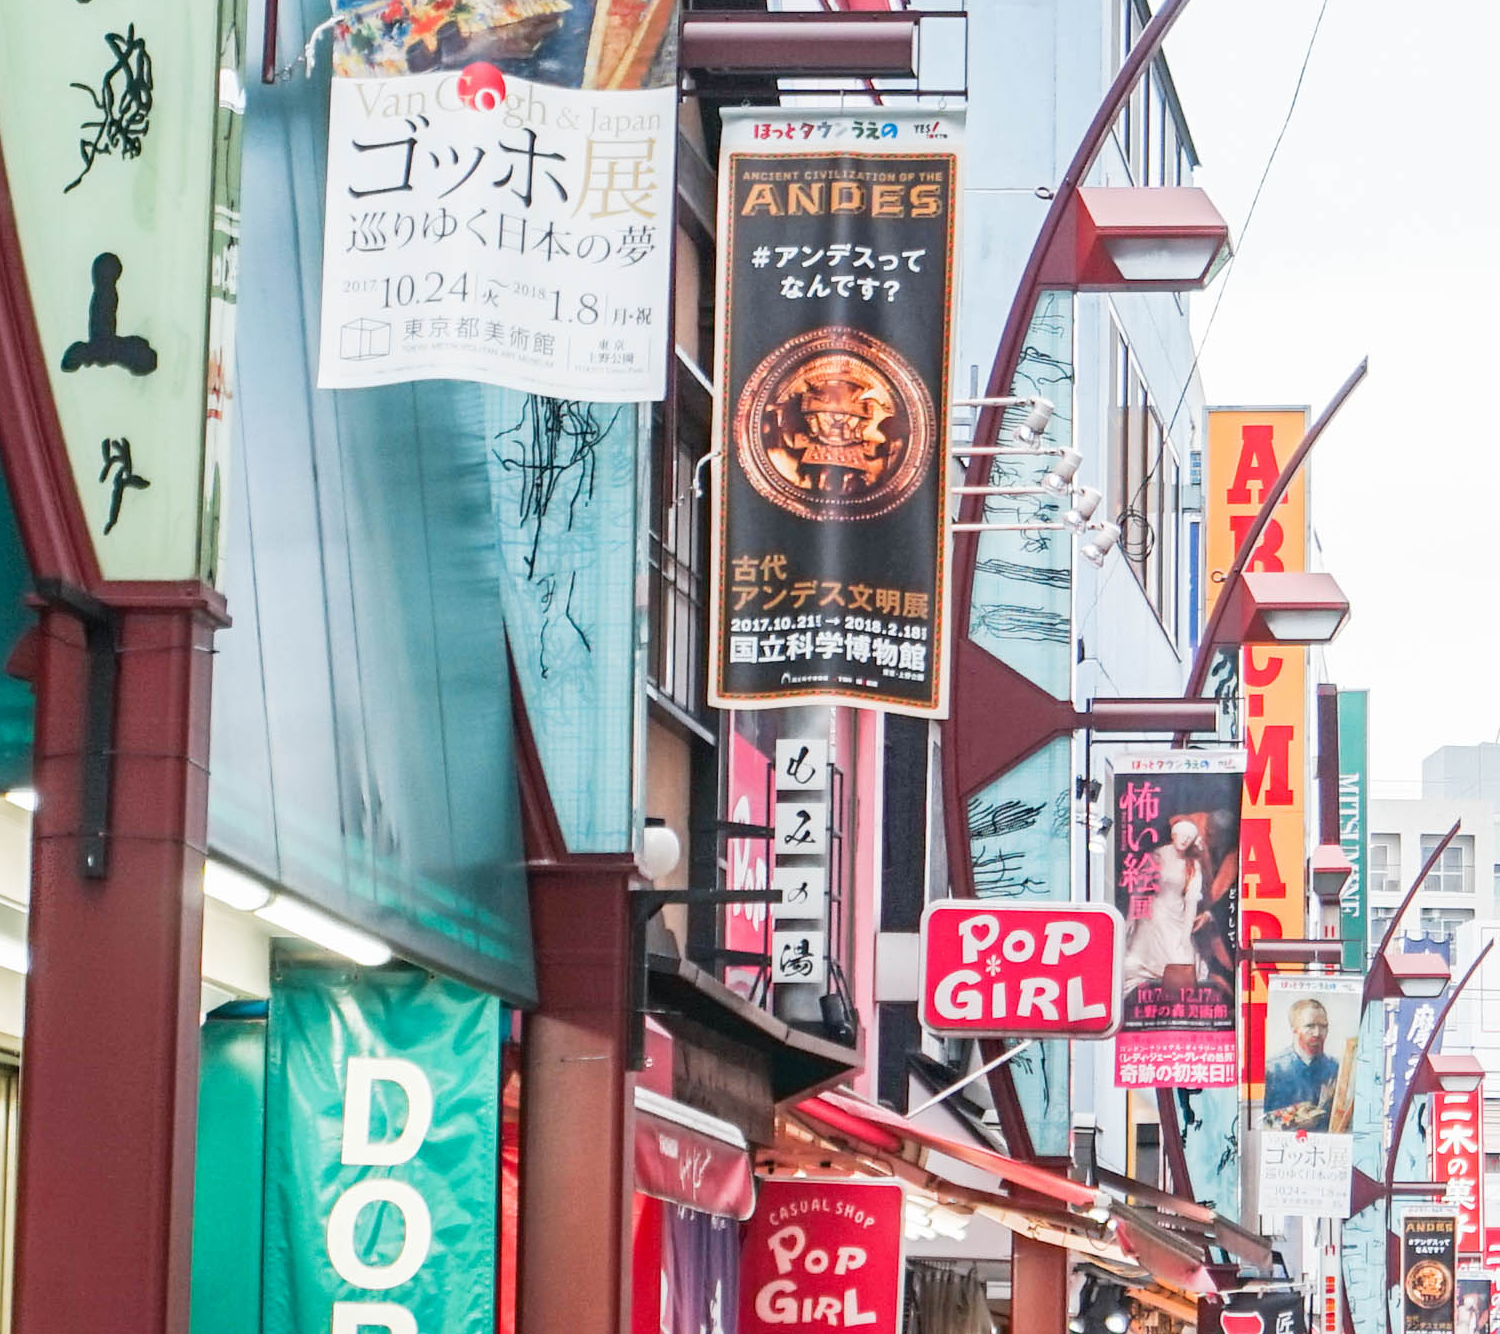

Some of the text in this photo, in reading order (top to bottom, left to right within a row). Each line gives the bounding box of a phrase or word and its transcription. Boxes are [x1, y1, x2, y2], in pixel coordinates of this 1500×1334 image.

[354, 81, 426, 119] Van
[557, 108, 580, 129] &
[588, 108, 661, 137] Japan
[753, 121, 898, 142] ほっとタウンうえの
[348, 115, 658, 221] ゴッホ展
[743, 169, 944, 183] ANCIENT CIVILIZATION OF THE
[741, 181, 943, 219] ANDES
[346, 208, 656, 267] 巡りゆく日本の夢
[750, 244, 926, 275] #アンデスって
[381, 271, 599, 325] 10.24 2018 1.8
[780, 273, 901, 304] なんです?
[403, 316, 556, 356] 東京都美術館
[732, 555, 787, 584] 古代
[731, 580, 929, 621] アンデス文明展
[729, 632, 928, 673] 国立科学博物館
[1119, 1063, 1235, 1084] 奇跡の初来日!!
[1265, 1145, 1348, 1167] ゴッホ展
[768, 1200, 878, 1227] CASUAL SHOP
[1406, 1222, 1453, 1233] ANDES
